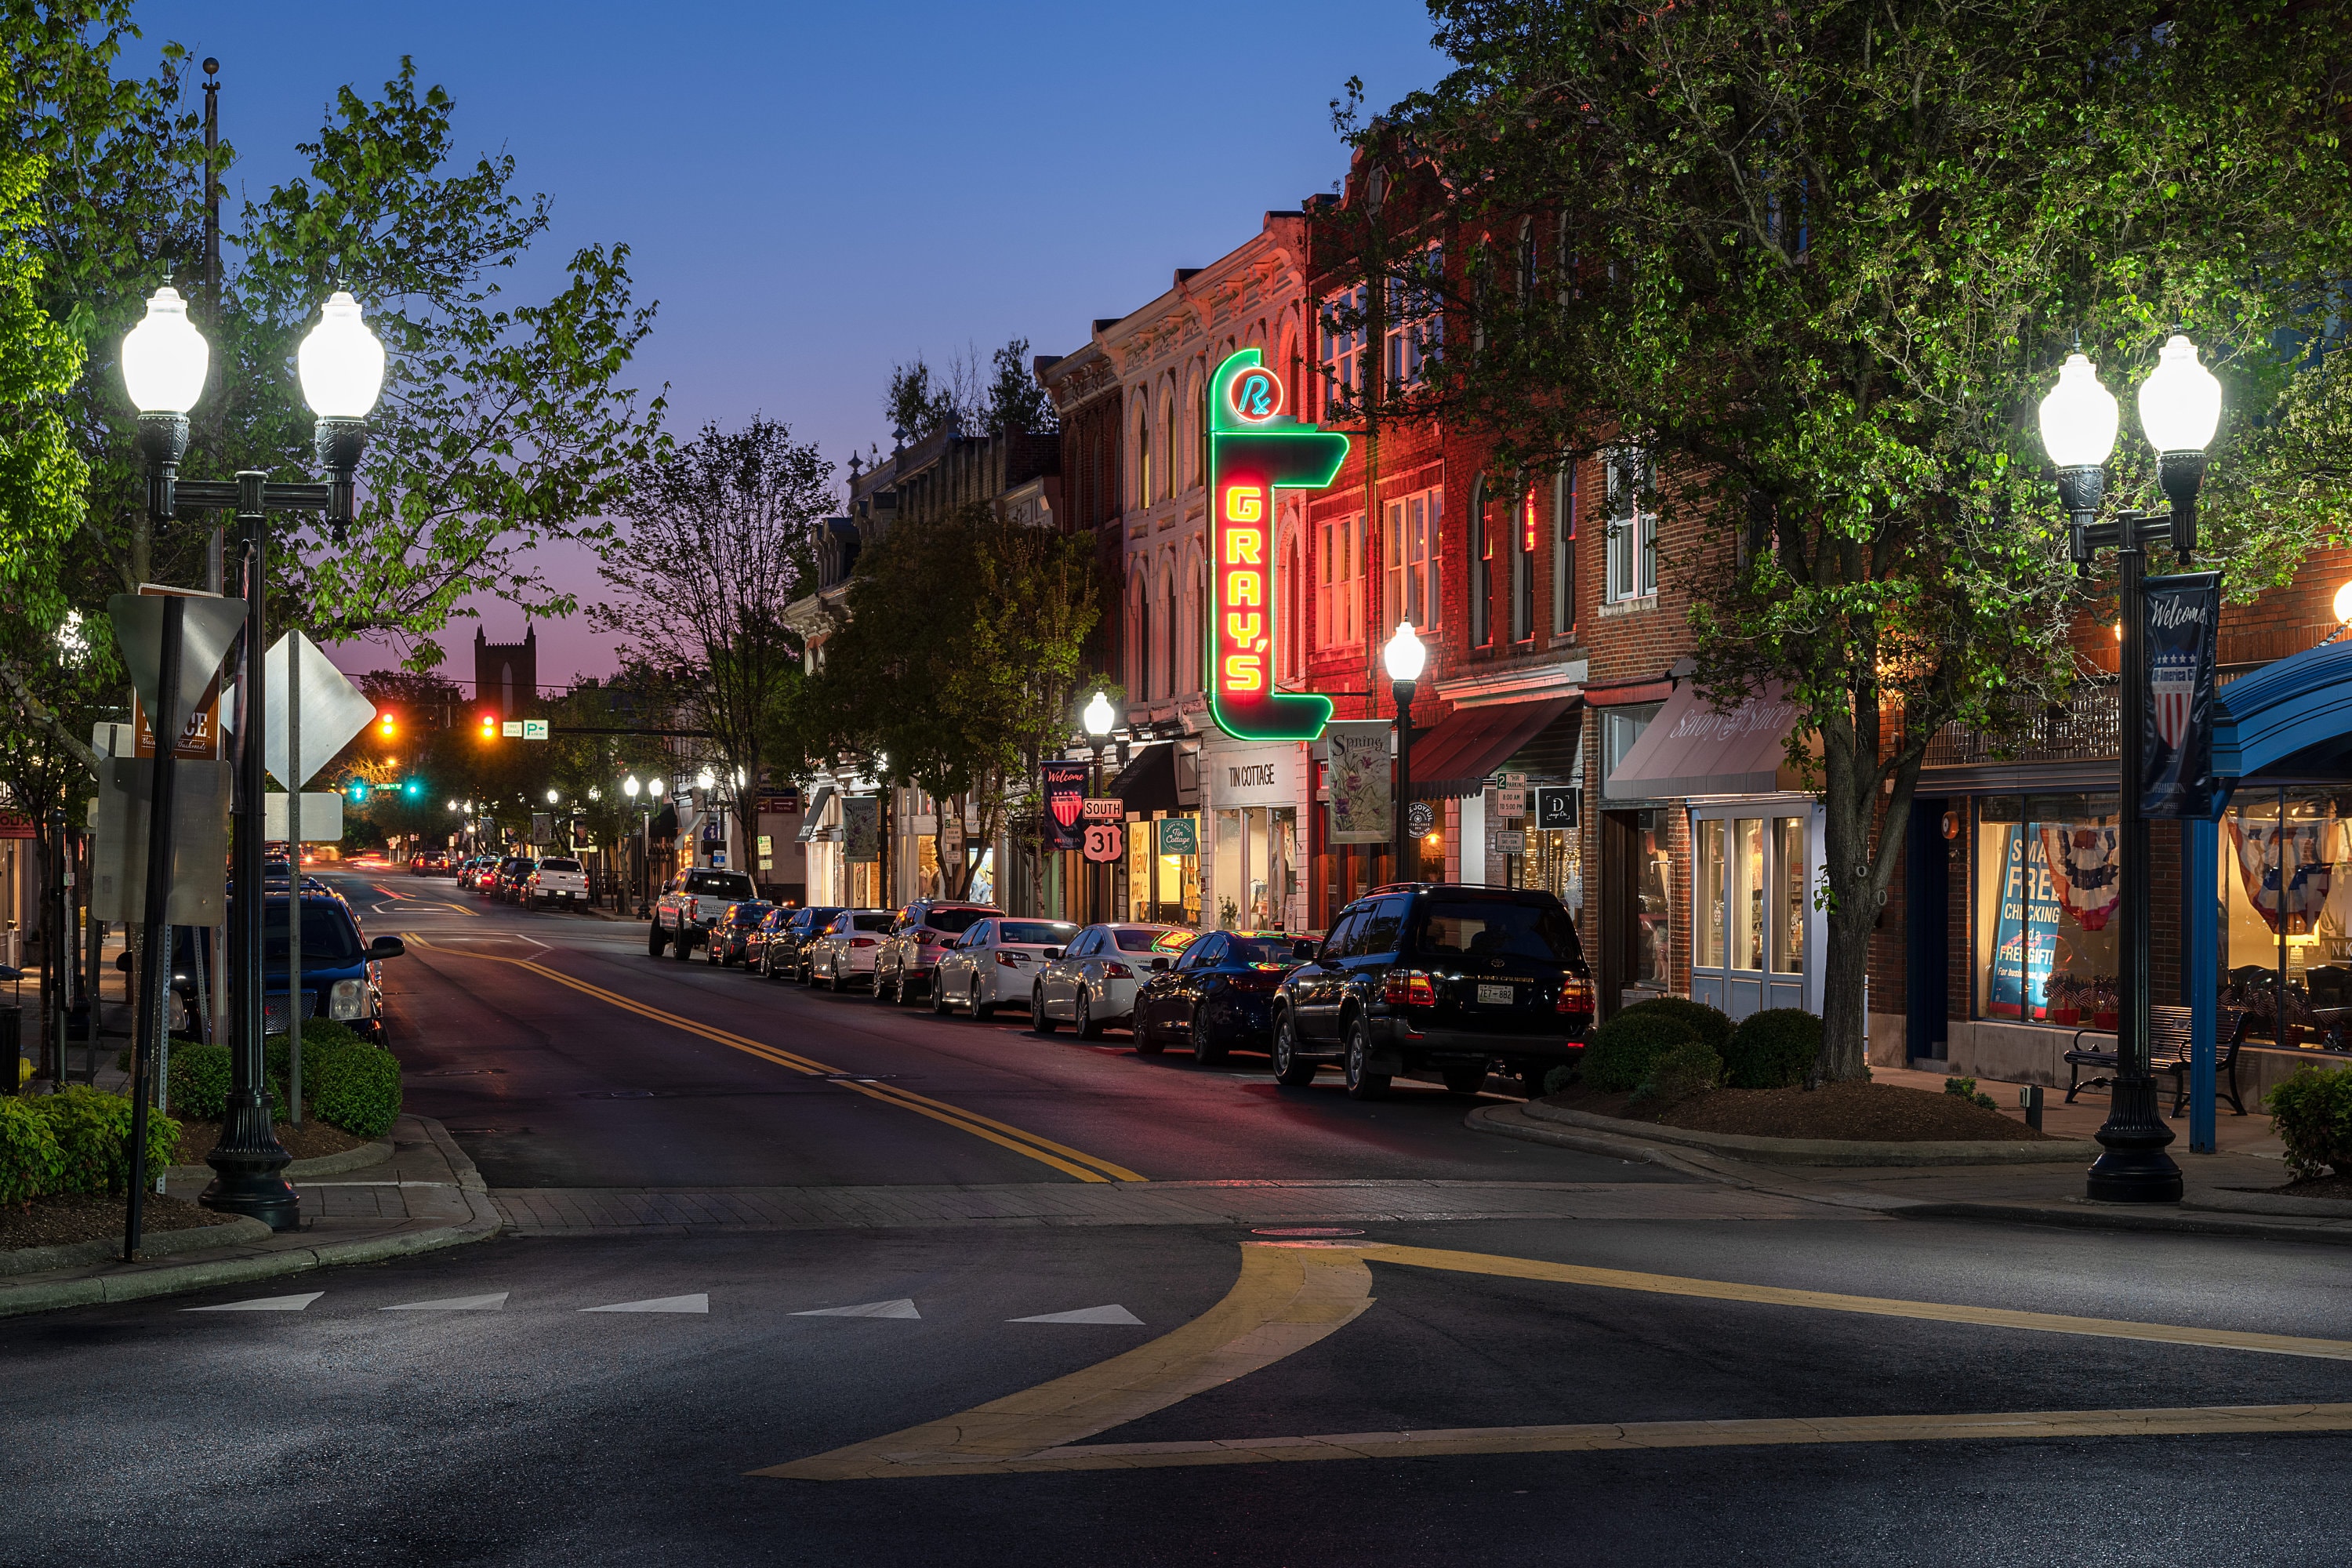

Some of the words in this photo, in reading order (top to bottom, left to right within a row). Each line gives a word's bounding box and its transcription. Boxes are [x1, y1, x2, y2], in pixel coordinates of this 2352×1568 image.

[1225, 485, 1268, 691] GRAY'S
[1740, 701, 1792, 738] Spice
[1333, 733, 1384, 757] Spring
[1048, 769, 1084, 783] Welcome
[1229, 767, 1240, 787] TIN
[1241, 763, 1275, 787] COTTAGE
[1498, 775, 1505, 787] 2
[845, 804, 874, 816] Spring
[1086, 802, 1120, 815] SOUTH
[1413, 804, 1433, 822] JOYFUL
[1166, 834, 1190, 844] Cottage
[1172, 828, 1183, 837] Tin
[1091, 832, 1113, 853] 31
[2019, 928, 2034, 940] ad
[2035, 931, 2041, 941] a
[2307, 941, 2352, 956] BANK
[2027, 948, 2054, 965] GIFT!
[1998, 967, 2007, 976] For
